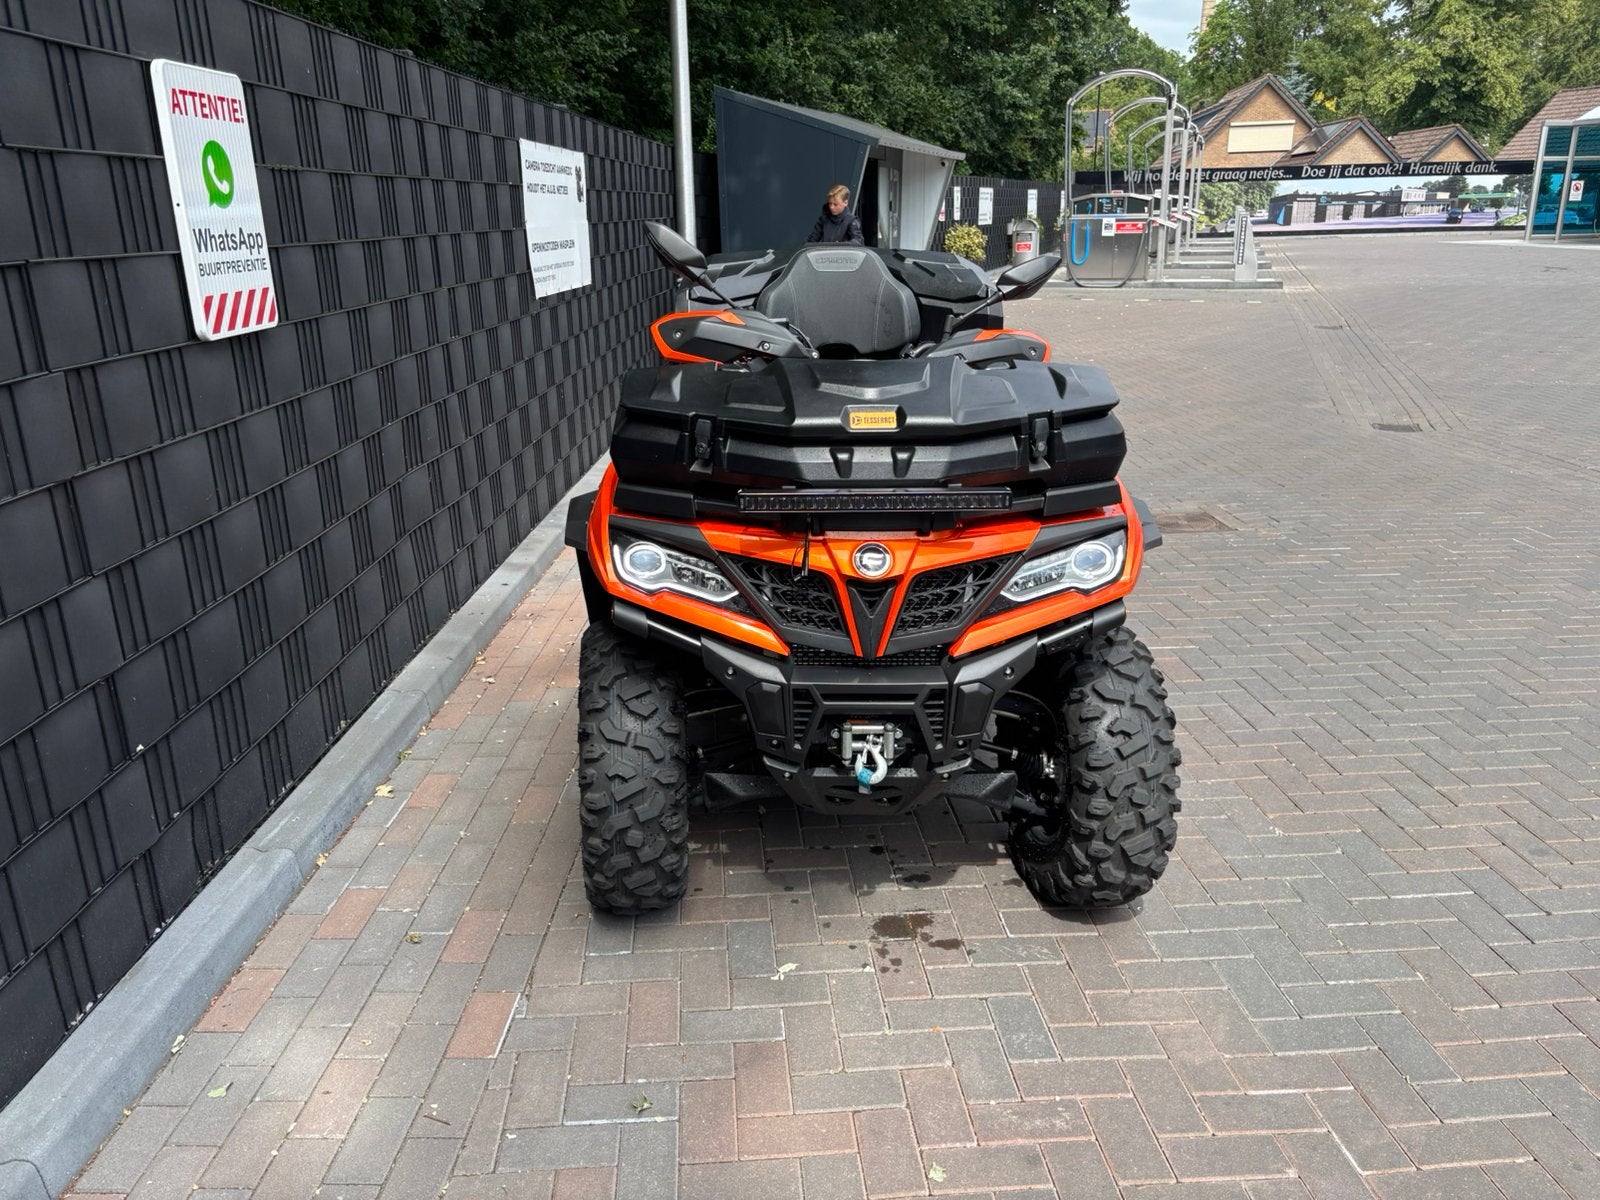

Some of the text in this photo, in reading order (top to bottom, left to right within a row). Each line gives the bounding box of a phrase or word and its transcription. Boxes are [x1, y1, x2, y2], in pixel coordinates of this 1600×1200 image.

[172, 88, 244, 123] ATTENTIE!
[1123, 170, 1143, 184] Wij
[1211, 170, 1247, 183] graag
[1248, 167, 1293, 182] netjes...
[1301, 165, 1326, 178] Doe
[1327, 164, 1342, 179] jij
[1344, 164, 1367, 176] dat
[1368, 162, 1404, 176] ook?!
[1409, 162, 1462, 177] Hartelijk
[1464, 161, 1498, 174] dank.
[192, 227, 264, 255] WhatsApp
[198, 258, 268, 277] BUURTPREVENTIE
[863, 416, 895, 424] TESSERACT
